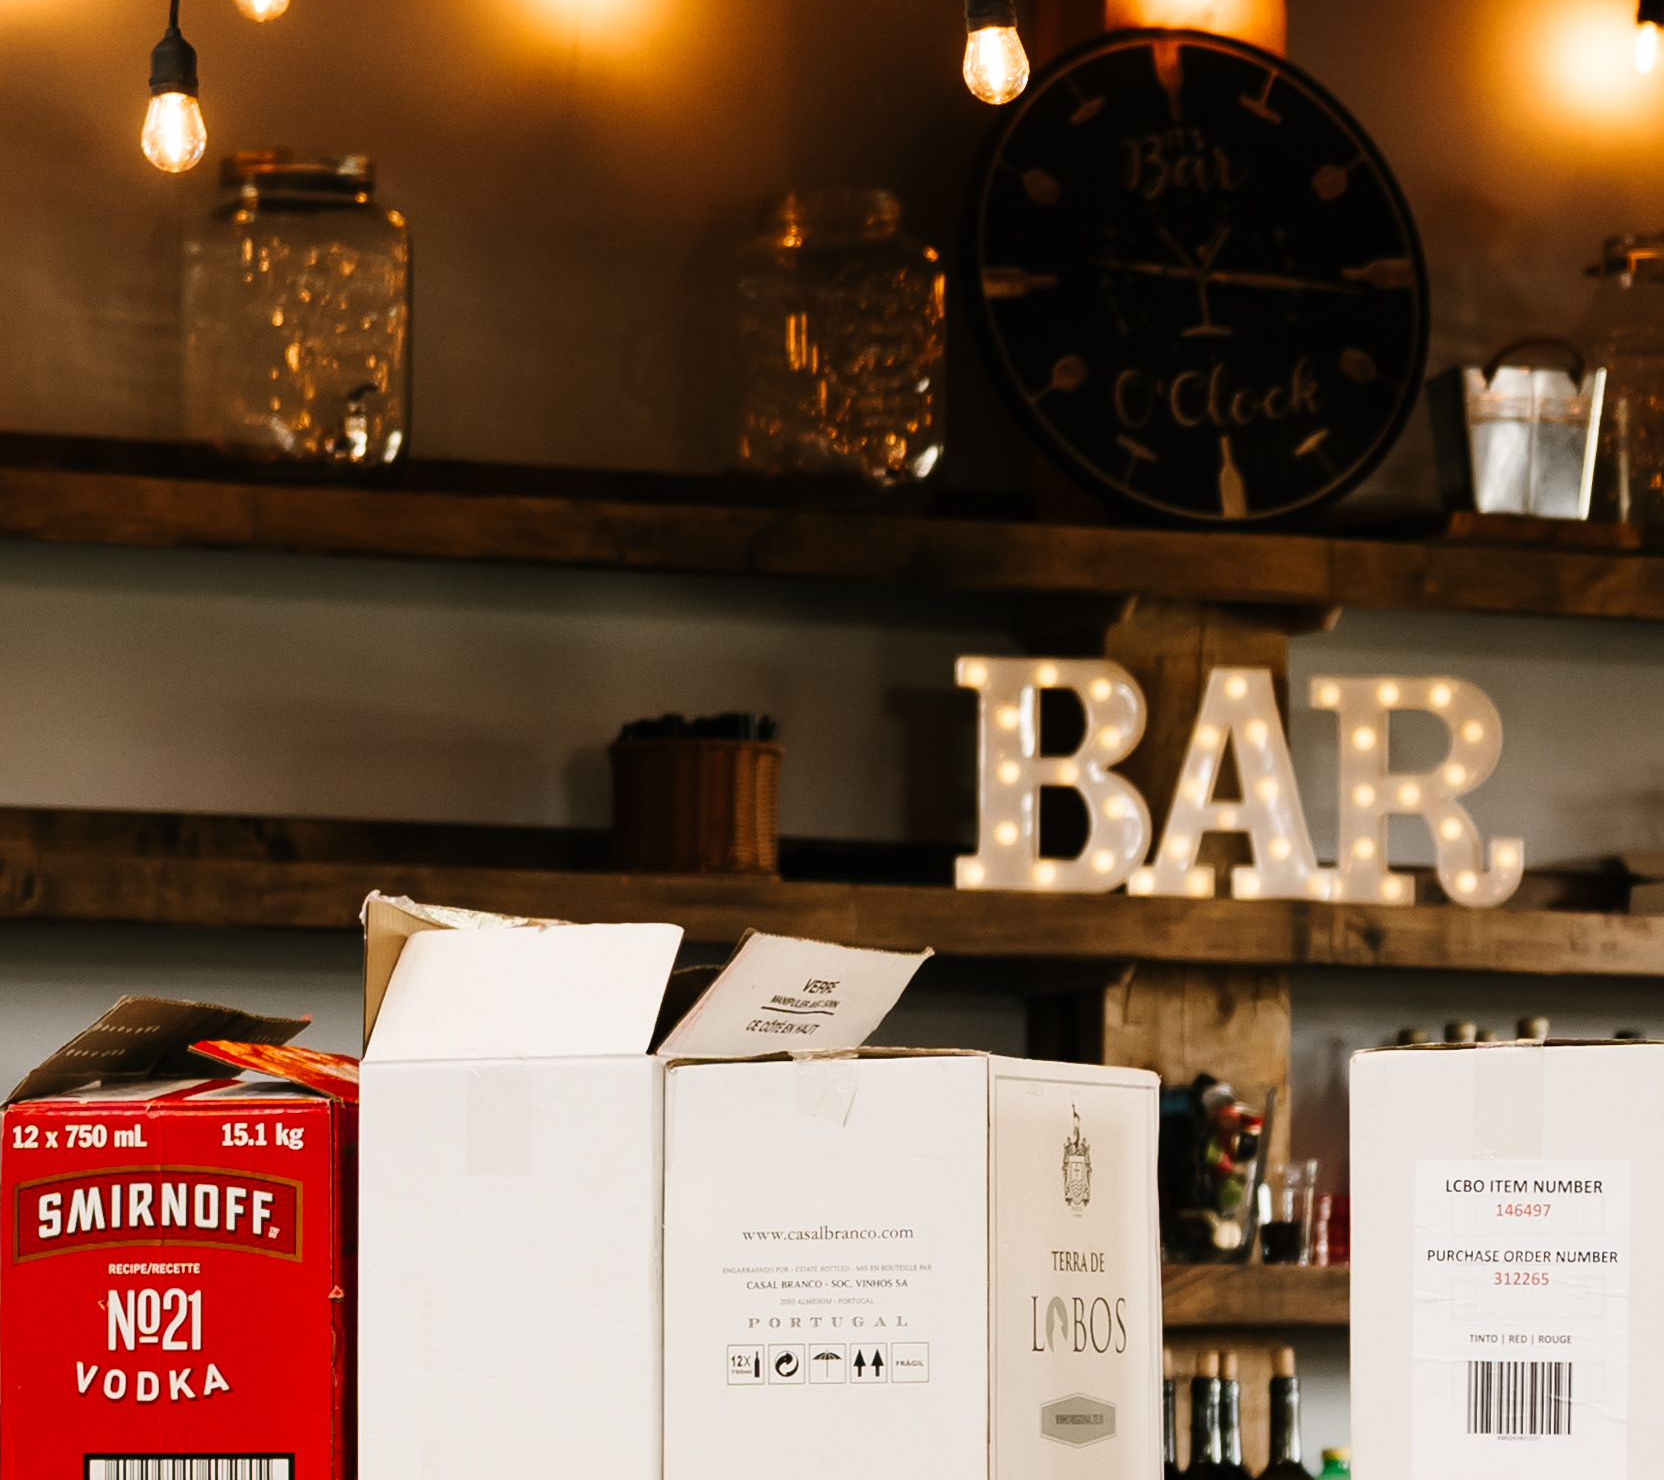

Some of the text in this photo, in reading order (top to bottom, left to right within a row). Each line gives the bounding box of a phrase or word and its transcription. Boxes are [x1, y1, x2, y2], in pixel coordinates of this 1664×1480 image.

[1120, 132, 1249, 200] Bar
[1114, 355, 1328, 429] O'Clock
[955, 656, 1524, 908] BAR
[12, 1123, 147, 1148] 12 x 750 mL
[221, 1122, 304, 1150] 15.1 kg
[1446, 1180, 1603, 1194] LCBO ITEM NUMBER
[37, 1181, 274, 1239] SMIRNOFF
[1496, 1204, 1551, 1217] 146497
[742, 1226, 914, 1241] www.casalbranco.com
[1051, 1251, 1105, 1272] TERRA DE
[1427, 1250, 1618, 1263] PURCHASE ORDER NUMBER
[108, 1263, 200, 1275] RECIPE/RECETTE
[746, 1281, 779, 1290] CASAL
[781, 1280, 823, 1289] BRANCO
[831, 1279, 853, 1289] SOC.
[856, 1279, 893, 1288] VINHOS
[895, 1279, 908, 1288] SA
[1494, 1272, 1550, 1285] 312265
[838, 1297, 875, 1305] PORTUGAL
[747, 1316, 909, 1329] PORTUGAL
[1469, 1334, 1498, 1343] TINTO
[1508, 1335, 1527, 1343] RED
[1538, 1335, 1572, 1344] ROUGE
[896, 1359, 924, 1367] FRÁGIL
[75, 1361, 230, 1402] VODKA
